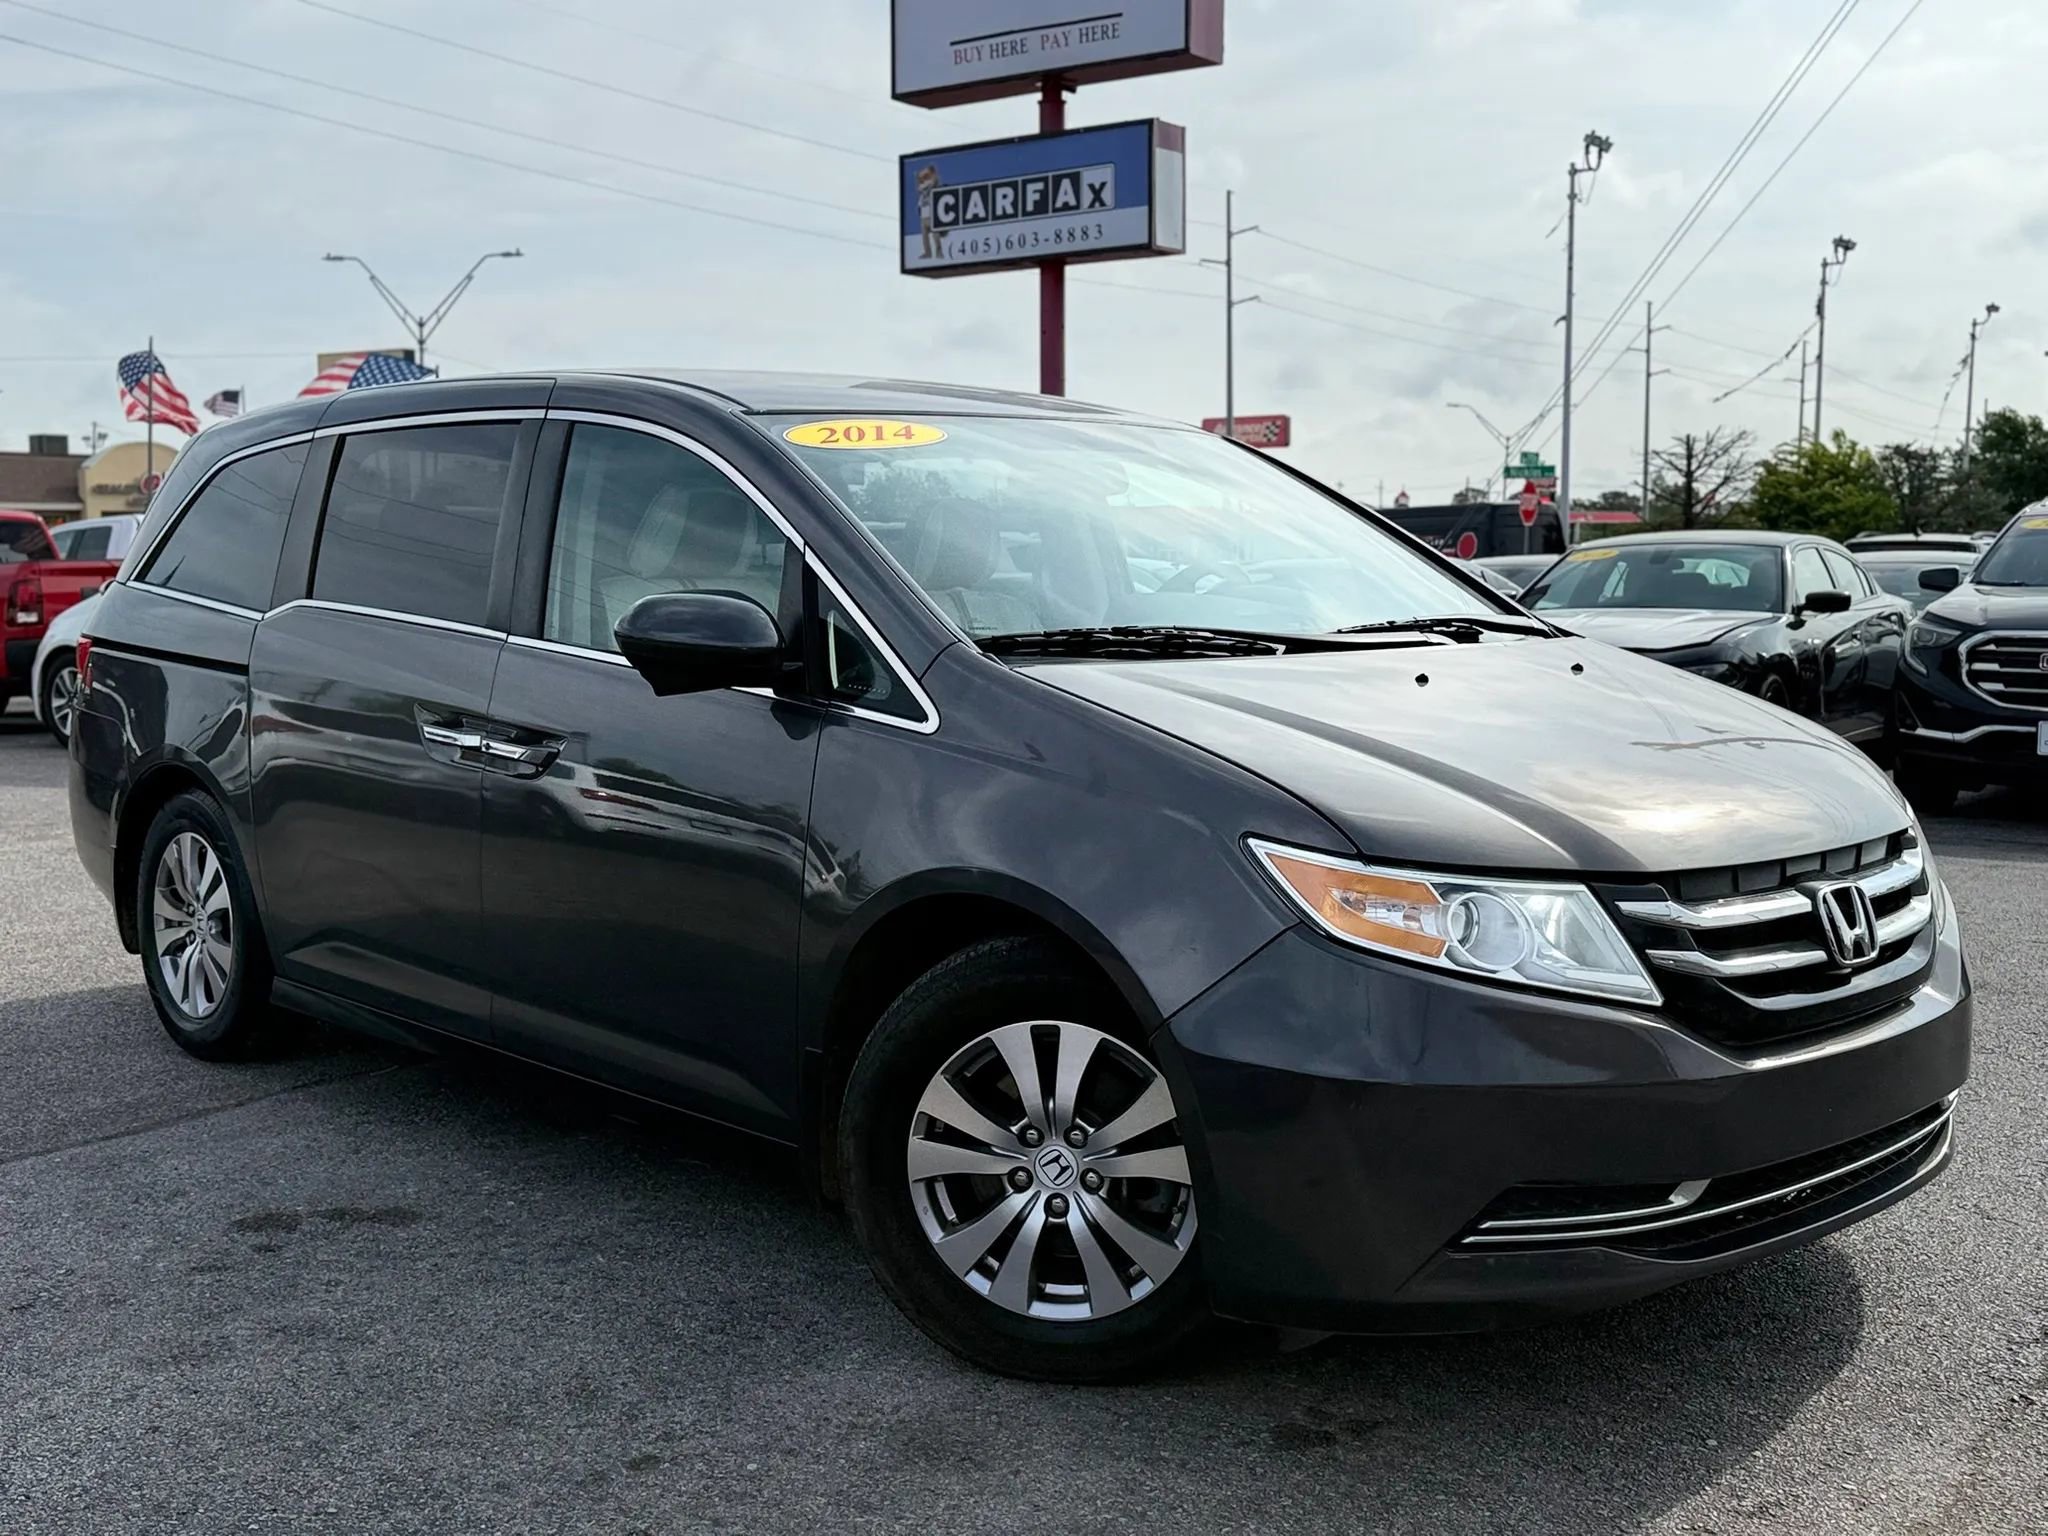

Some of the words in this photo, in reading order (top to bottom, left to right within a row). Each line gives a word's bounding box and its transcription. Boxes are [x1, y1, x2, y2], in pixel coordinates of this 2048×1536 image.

[953, 45, 984, 65] BUY
[989, 37, 1028, 60] HERE
[1040, 30, 1071, 51] PAY
[1078, 22, 1120, 44] HERE
[936, 178, 1109, 223] CARFAX
[949, 224, 1104, 259] (405)603-8883
[817, 425, 915, 444] 2014
